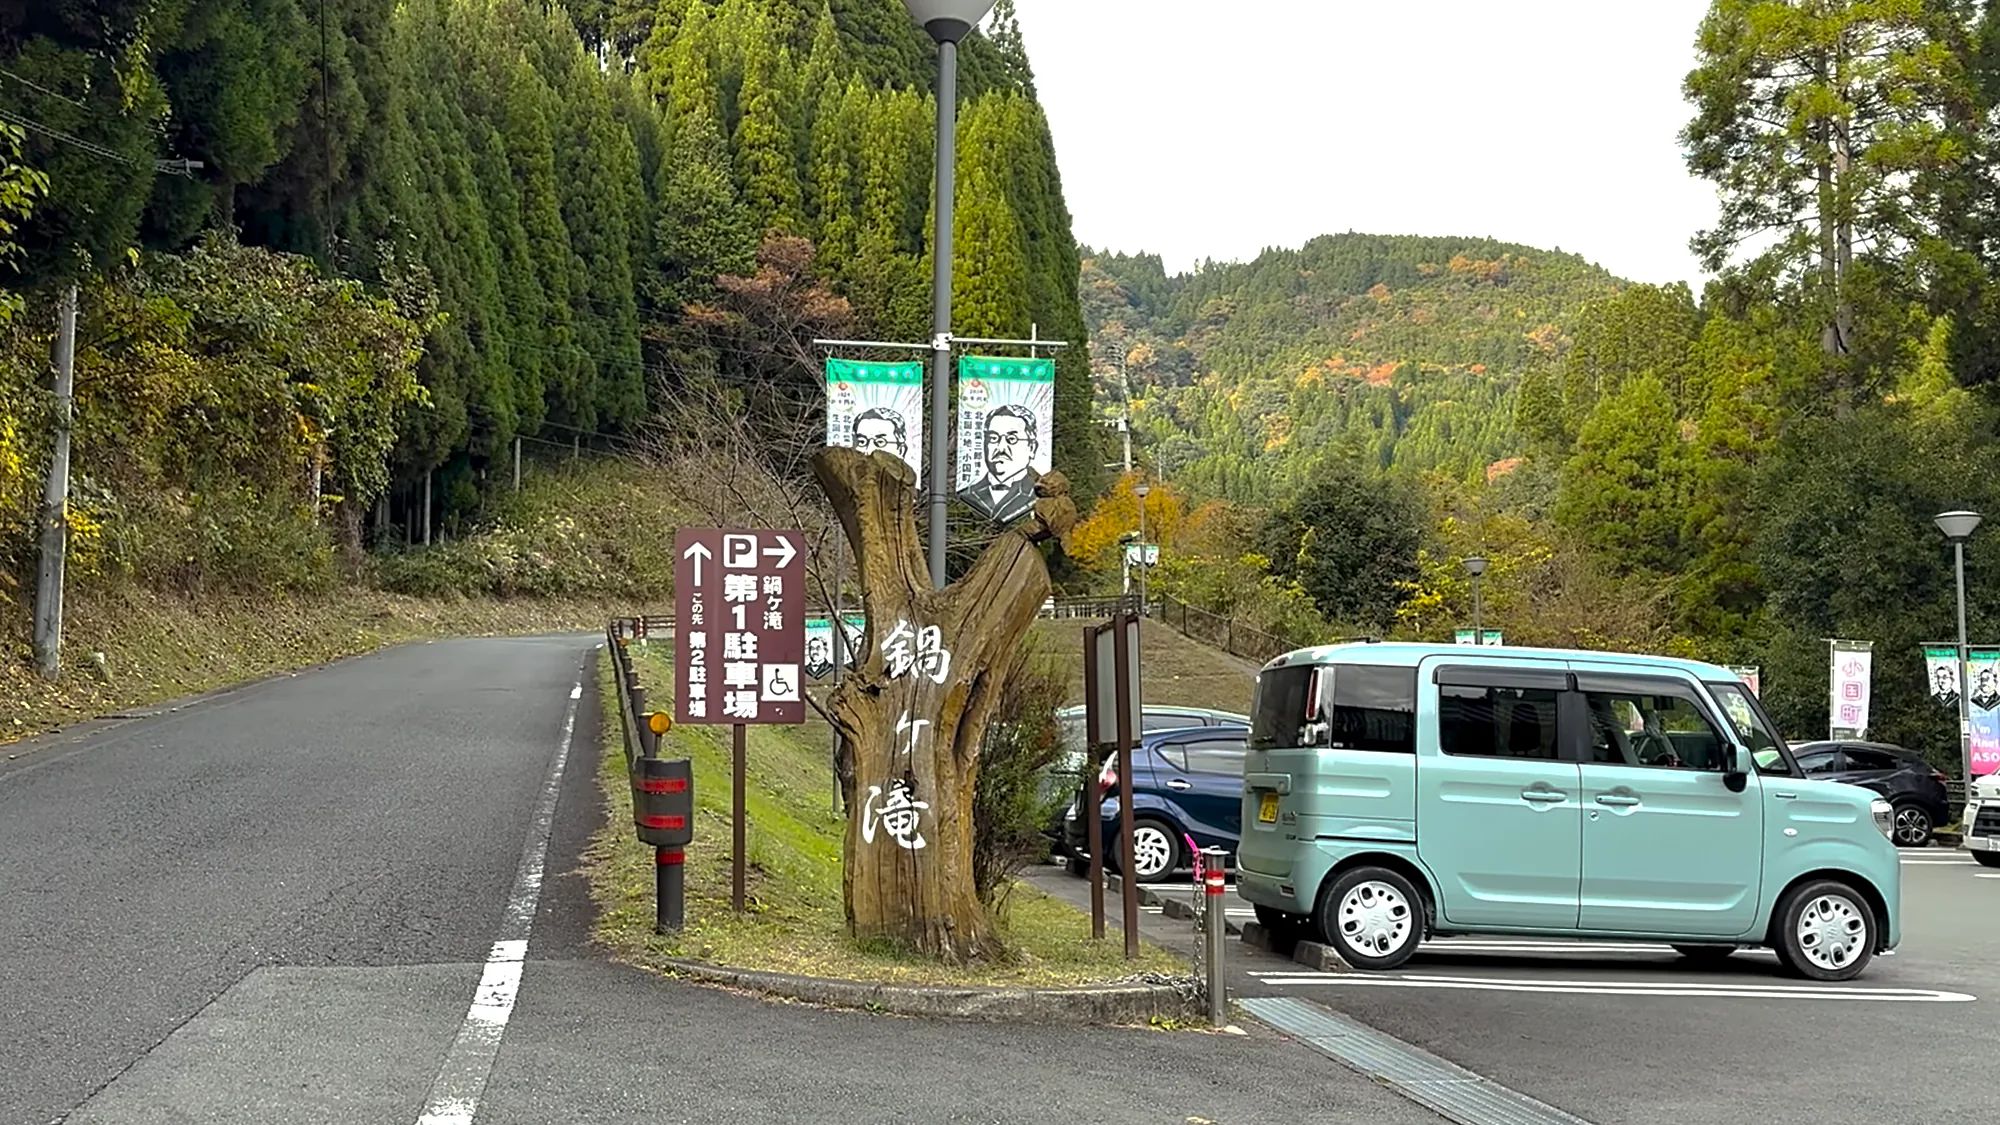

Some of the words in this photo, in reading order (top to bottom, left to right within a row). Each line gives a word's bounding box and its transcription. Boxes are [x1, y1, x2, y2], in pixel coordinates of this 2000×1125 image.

[729, 538, 752, 565] P
[691, 593, 704, 626] この先
[723, 574, 758, 719] 第1駐車場
[688, 631, 706, 718] 第2駐車場
[1841, 658, 1864, 725] 小国町
[1973, 751, 2000, 763] ASO
